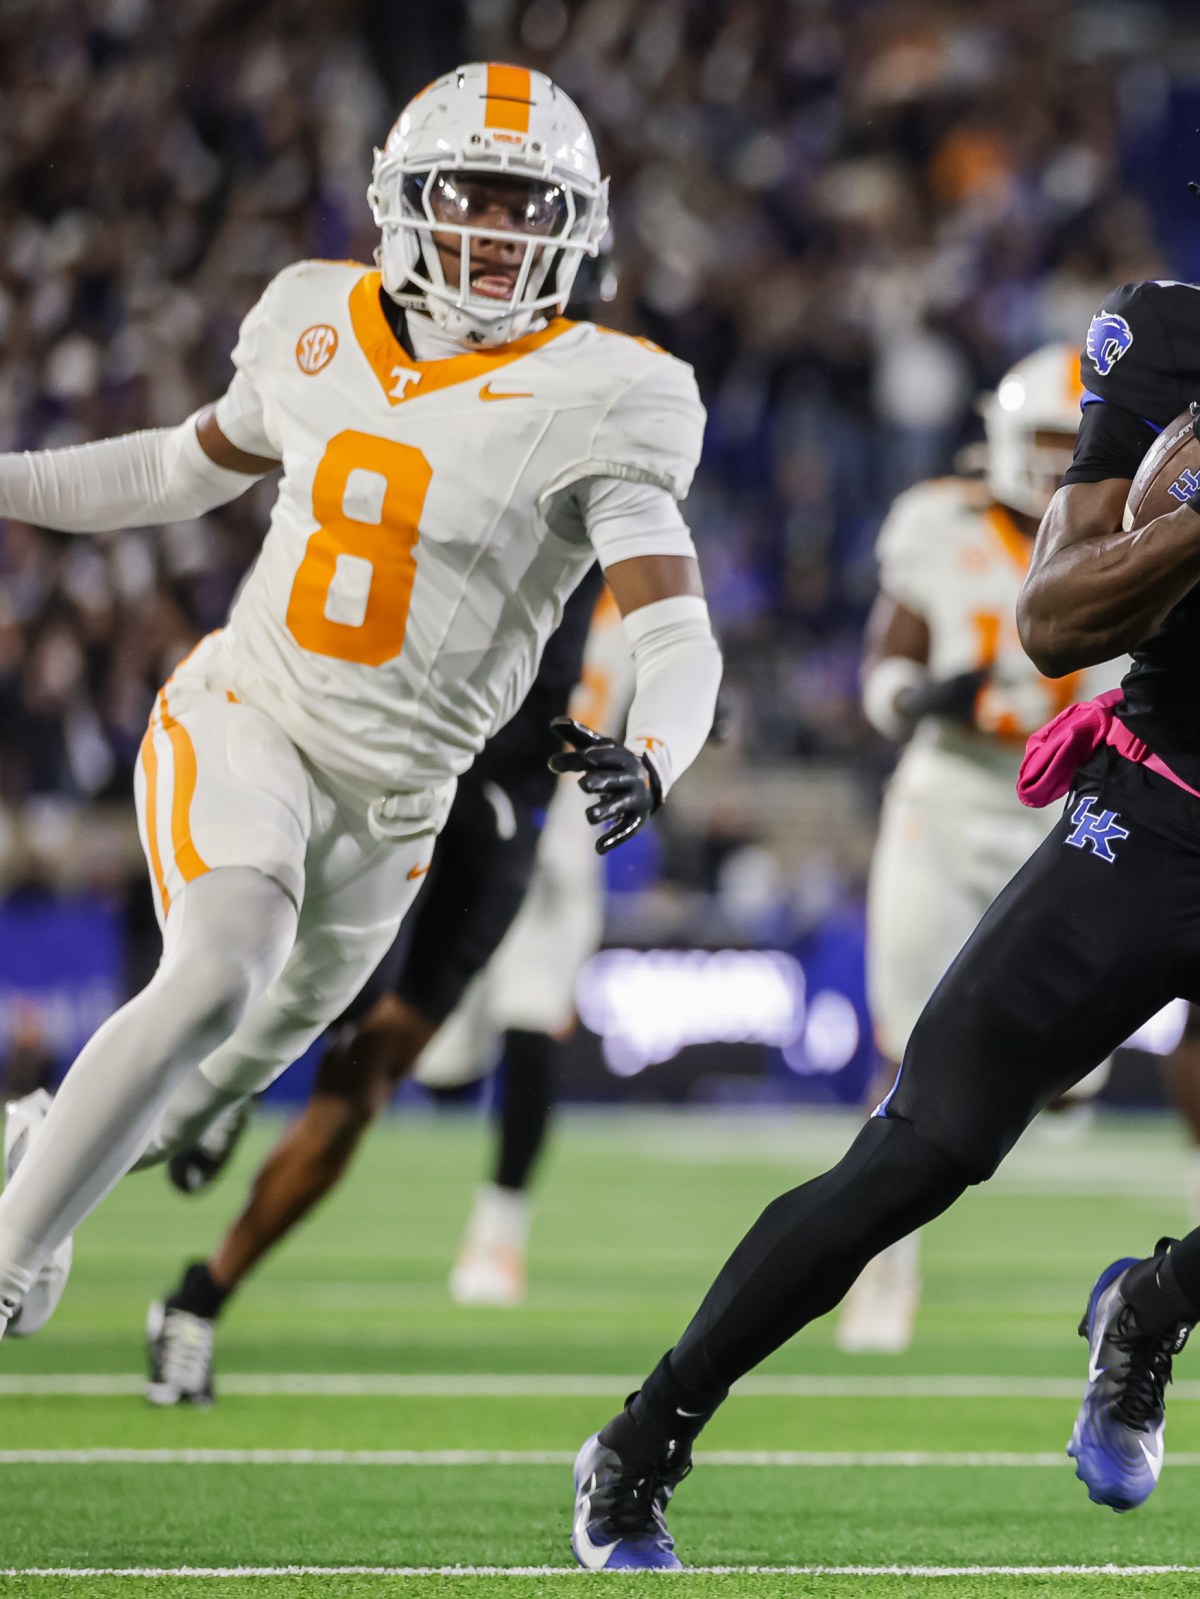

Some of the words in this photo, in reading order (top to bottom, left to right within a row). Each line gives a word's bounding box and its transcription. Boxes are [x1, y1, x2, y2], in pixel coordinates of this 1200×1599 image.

[298, 327, 336, 373] SEC
[389, 366, 421, 399] T
[286, 428, 433, 668] 8
[1064, 796, 1129, 863] UK
